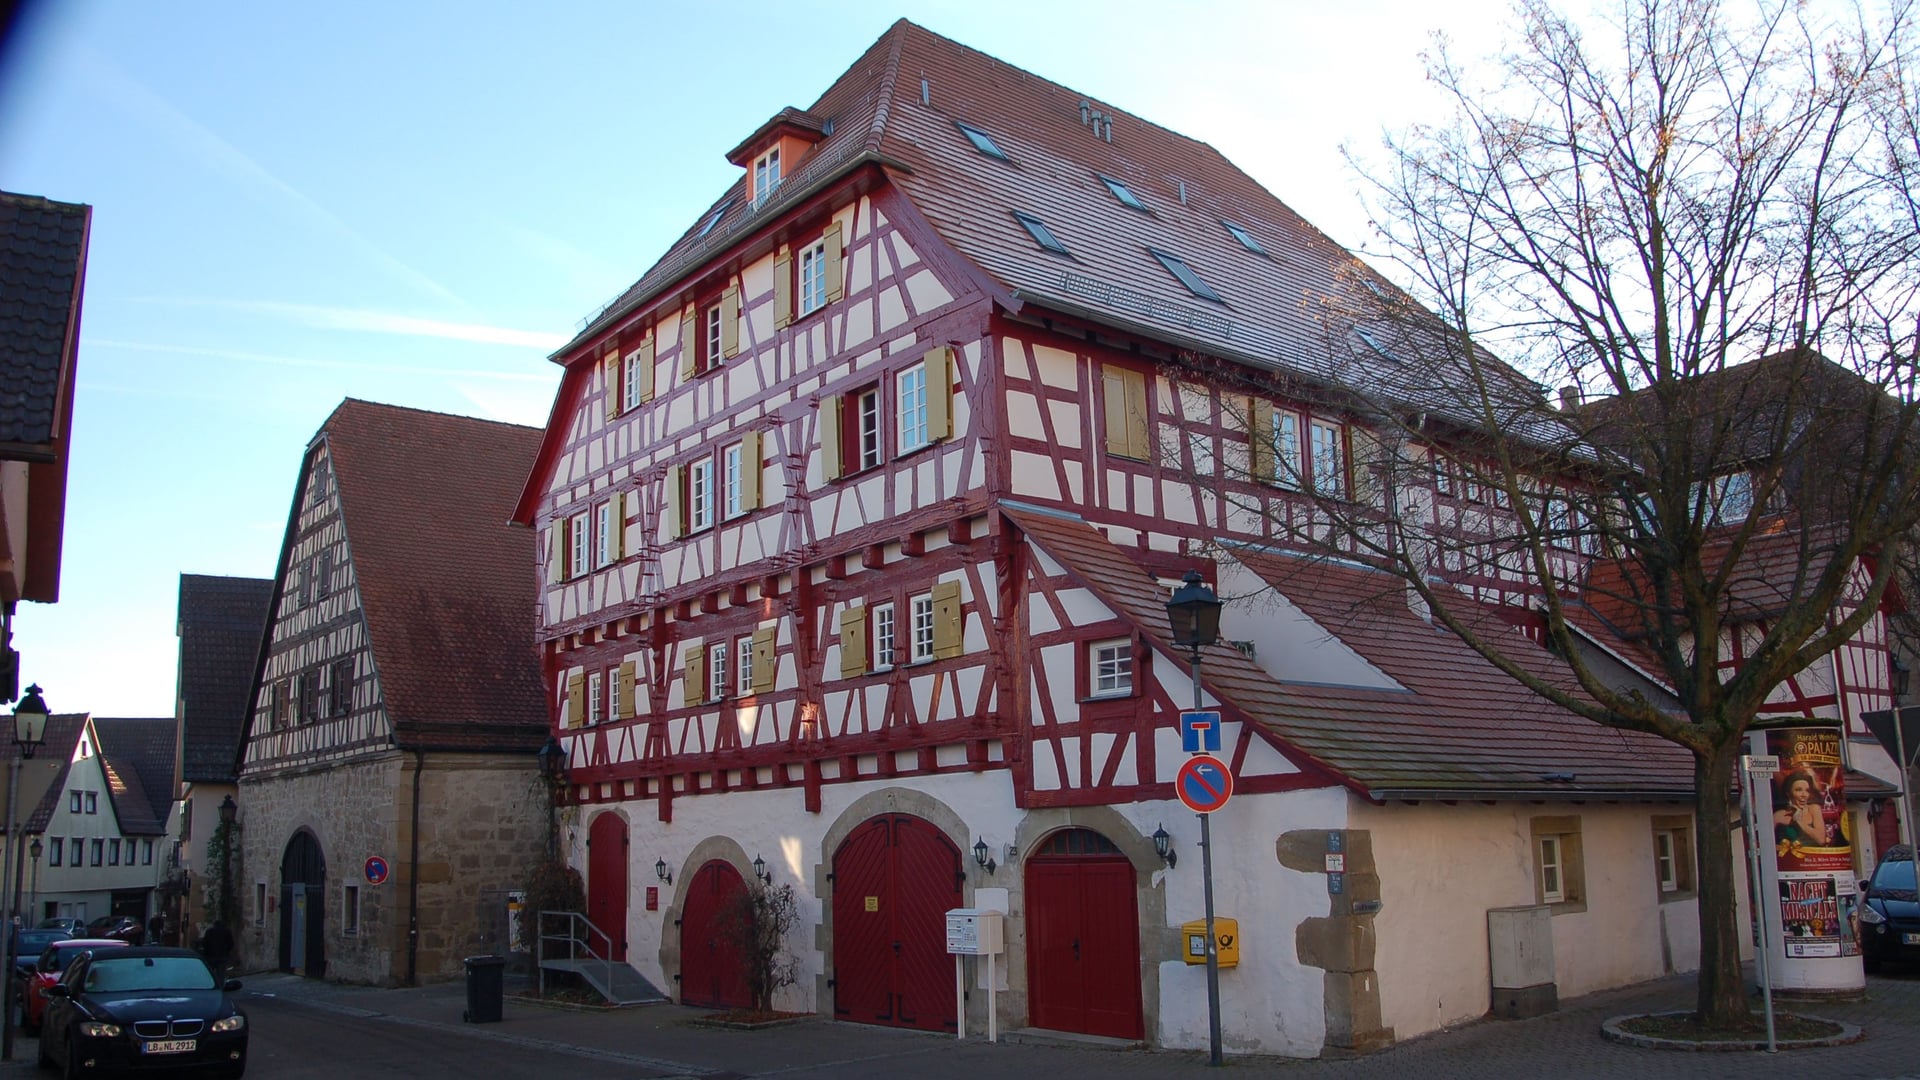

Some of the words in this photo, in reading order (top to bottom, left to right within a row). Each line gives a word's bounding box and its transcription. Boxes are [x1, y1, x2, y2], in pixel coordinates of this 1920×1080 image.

[1009, 846, 1018, 856] 23
[1788, 881, 1828, 901] NACHT
[1782, 901, 1837, 920] MUSICALS
[147, 1043, 158, 1051] LB
[164, 1042, 174, 1050] NL
[176, 1041, 195, 1050] 2912
